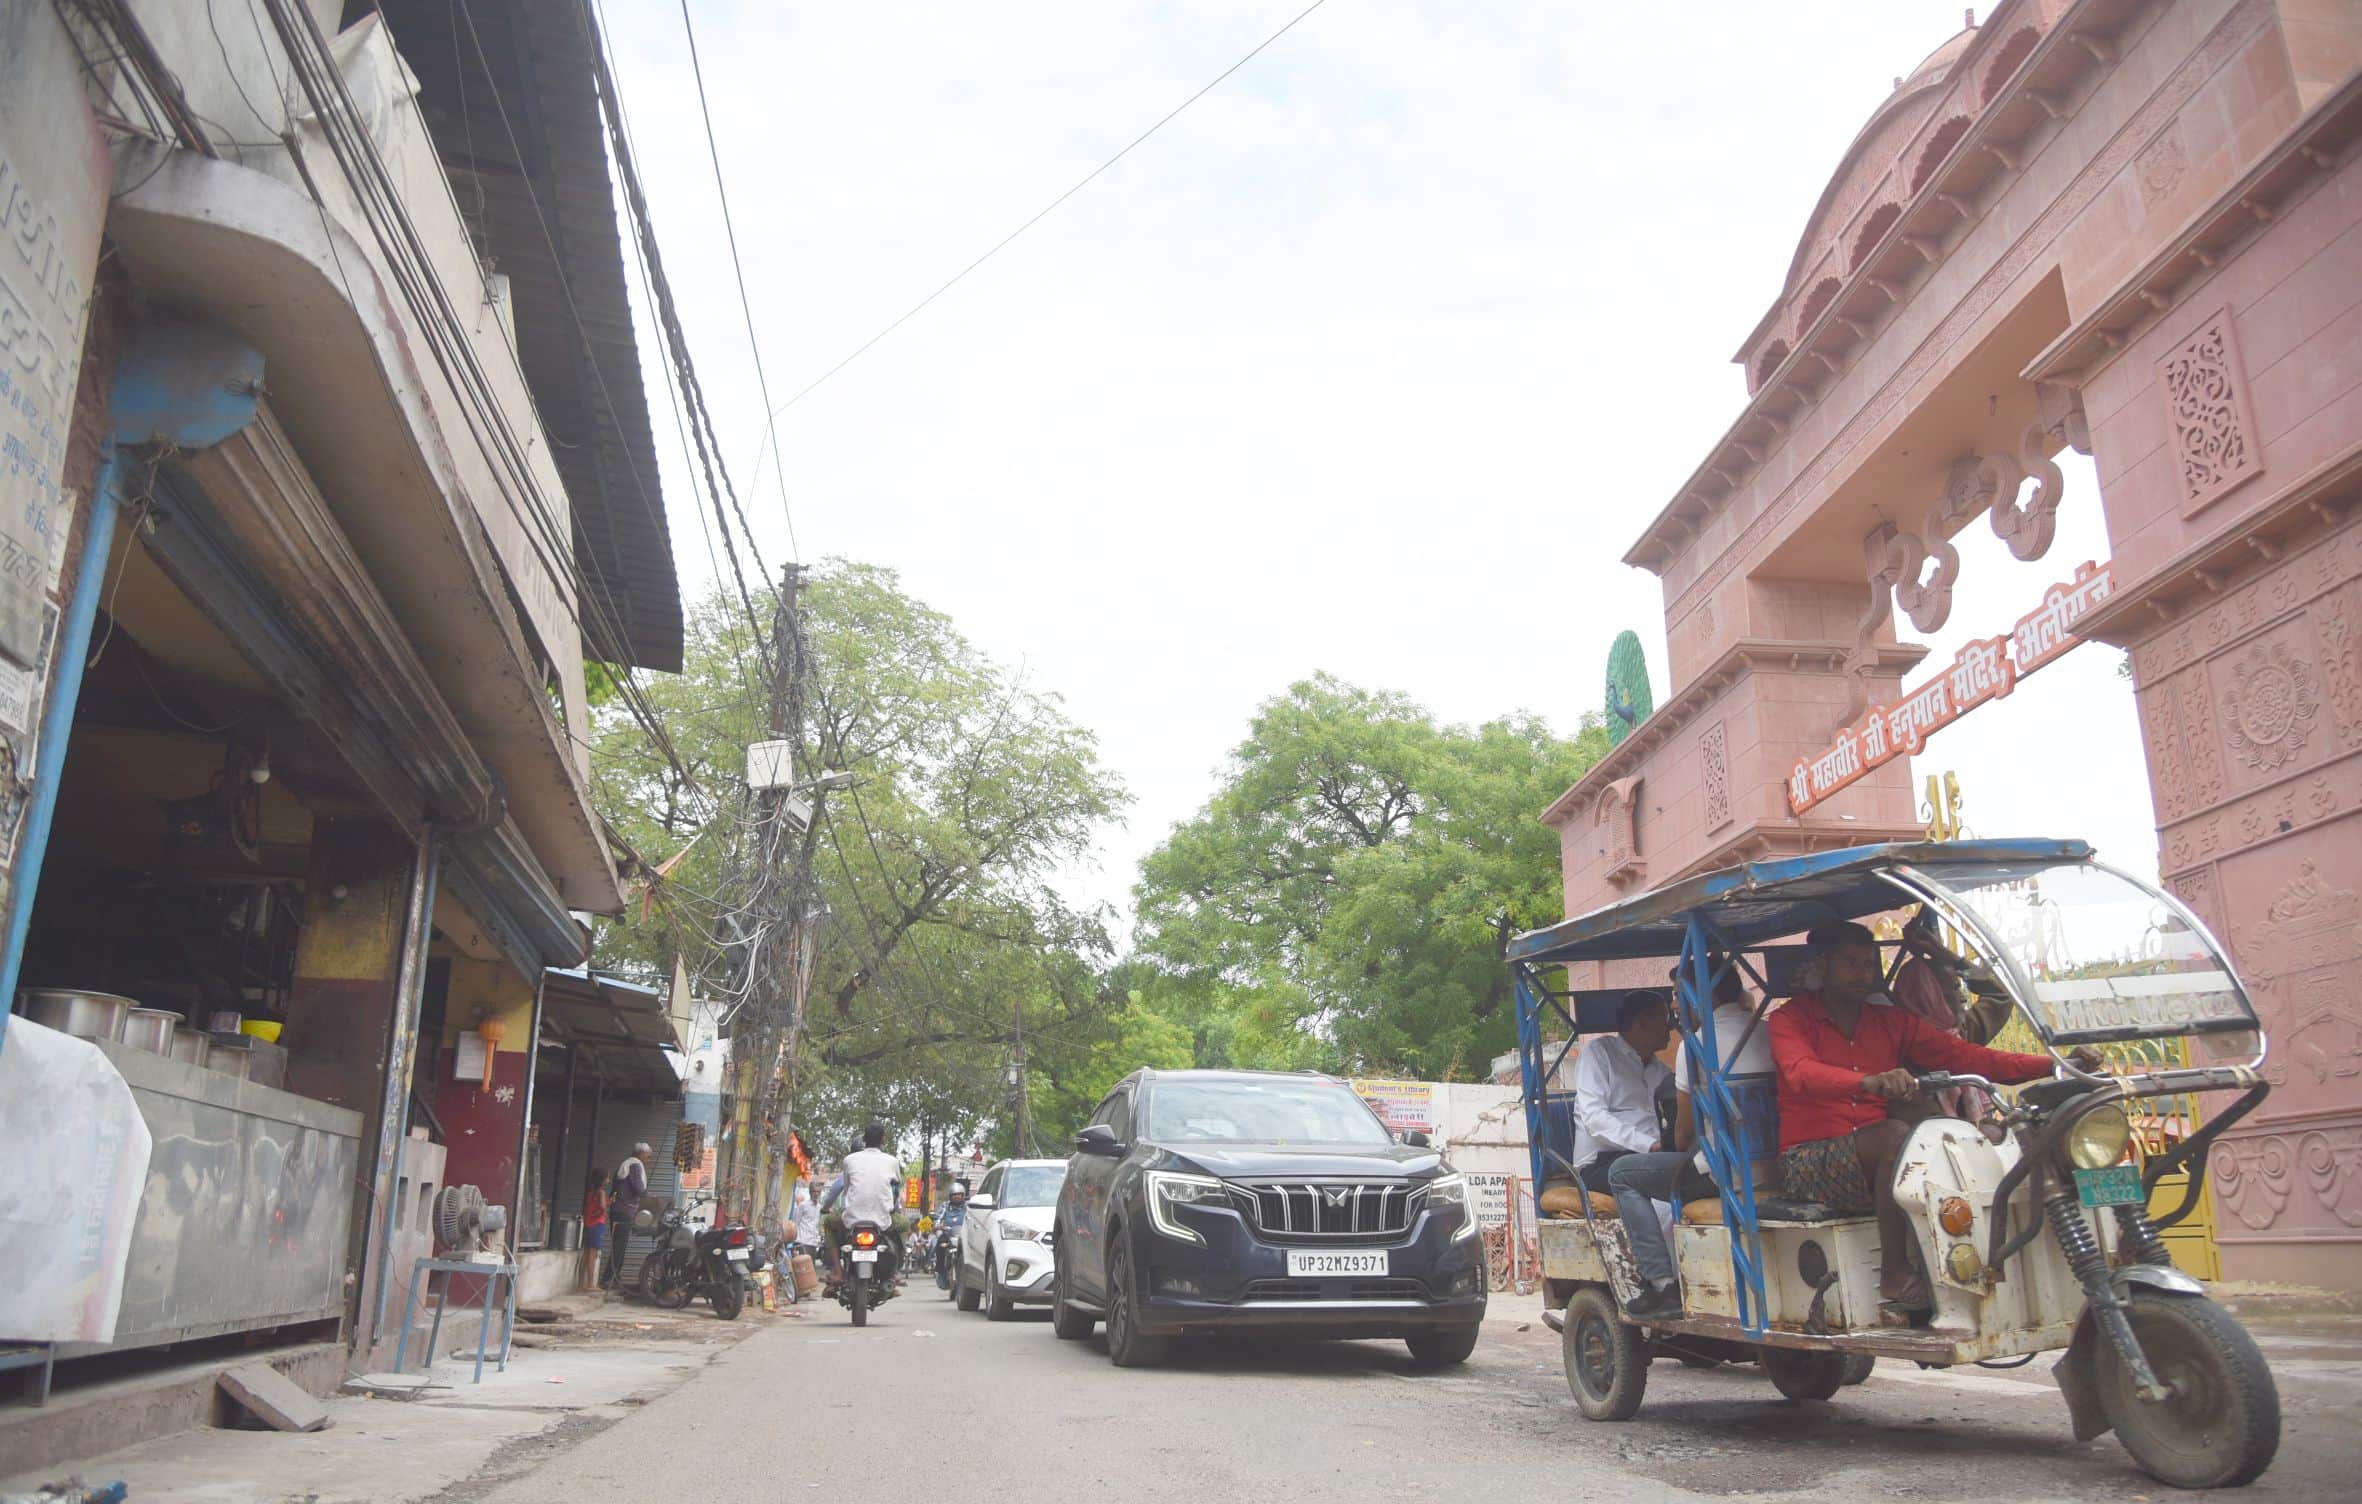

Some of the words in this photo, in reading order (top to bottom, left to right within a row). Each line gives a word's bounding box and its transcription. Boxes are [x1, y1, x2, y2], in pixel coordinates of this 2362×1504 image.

[1791, 764, 1809, 807] श्री
[1810, 735, 1860, 791] महावीर
[1861, 712, 1886, 760] जी
[1888, 680, 1948, 749] हनुमान
[1469, 1176, 1487, 1186] LDA
[1490, 1176, 1507, 1186] APA
[1299, 1256, 1385, 1272] UP32MZ9371
